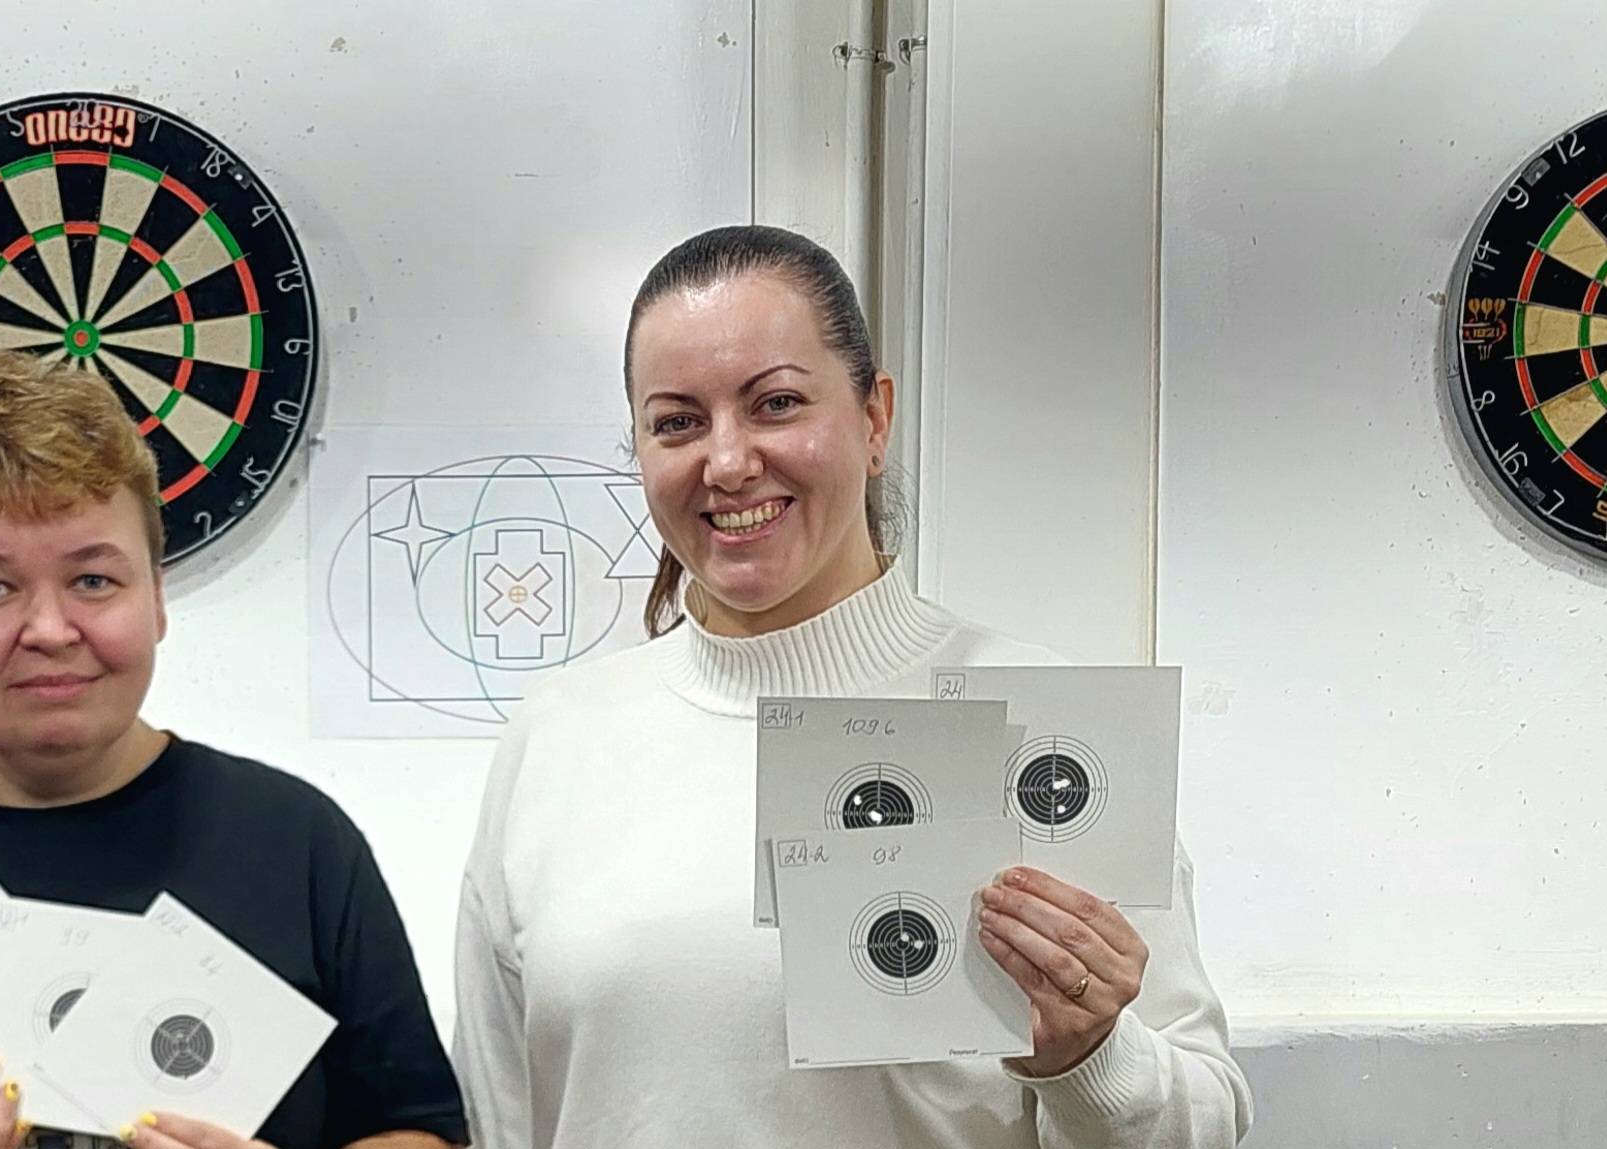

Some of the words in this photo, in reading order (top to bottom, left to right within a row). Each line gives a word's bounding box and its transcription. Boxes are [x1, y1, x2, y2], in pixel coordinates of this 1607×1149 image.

[6, 108, 25, 138] 5
[200, 145, 230, 178] 18
[1552, 131, 1586, 165] 12
[1504, 183, 1529, 210] 9
[251, 204, 276, 228] 4
[1469, 240, 1501, 273] 14
[273, 259, 305, 293] 13
[270, 399, 302, 433] 10
[1471, 390, 1496, 412] 8
[1494, 441, 1528, 477] 16
[1542, 489, 1566, 516] 7
[193, 511, 213, 539] 2
